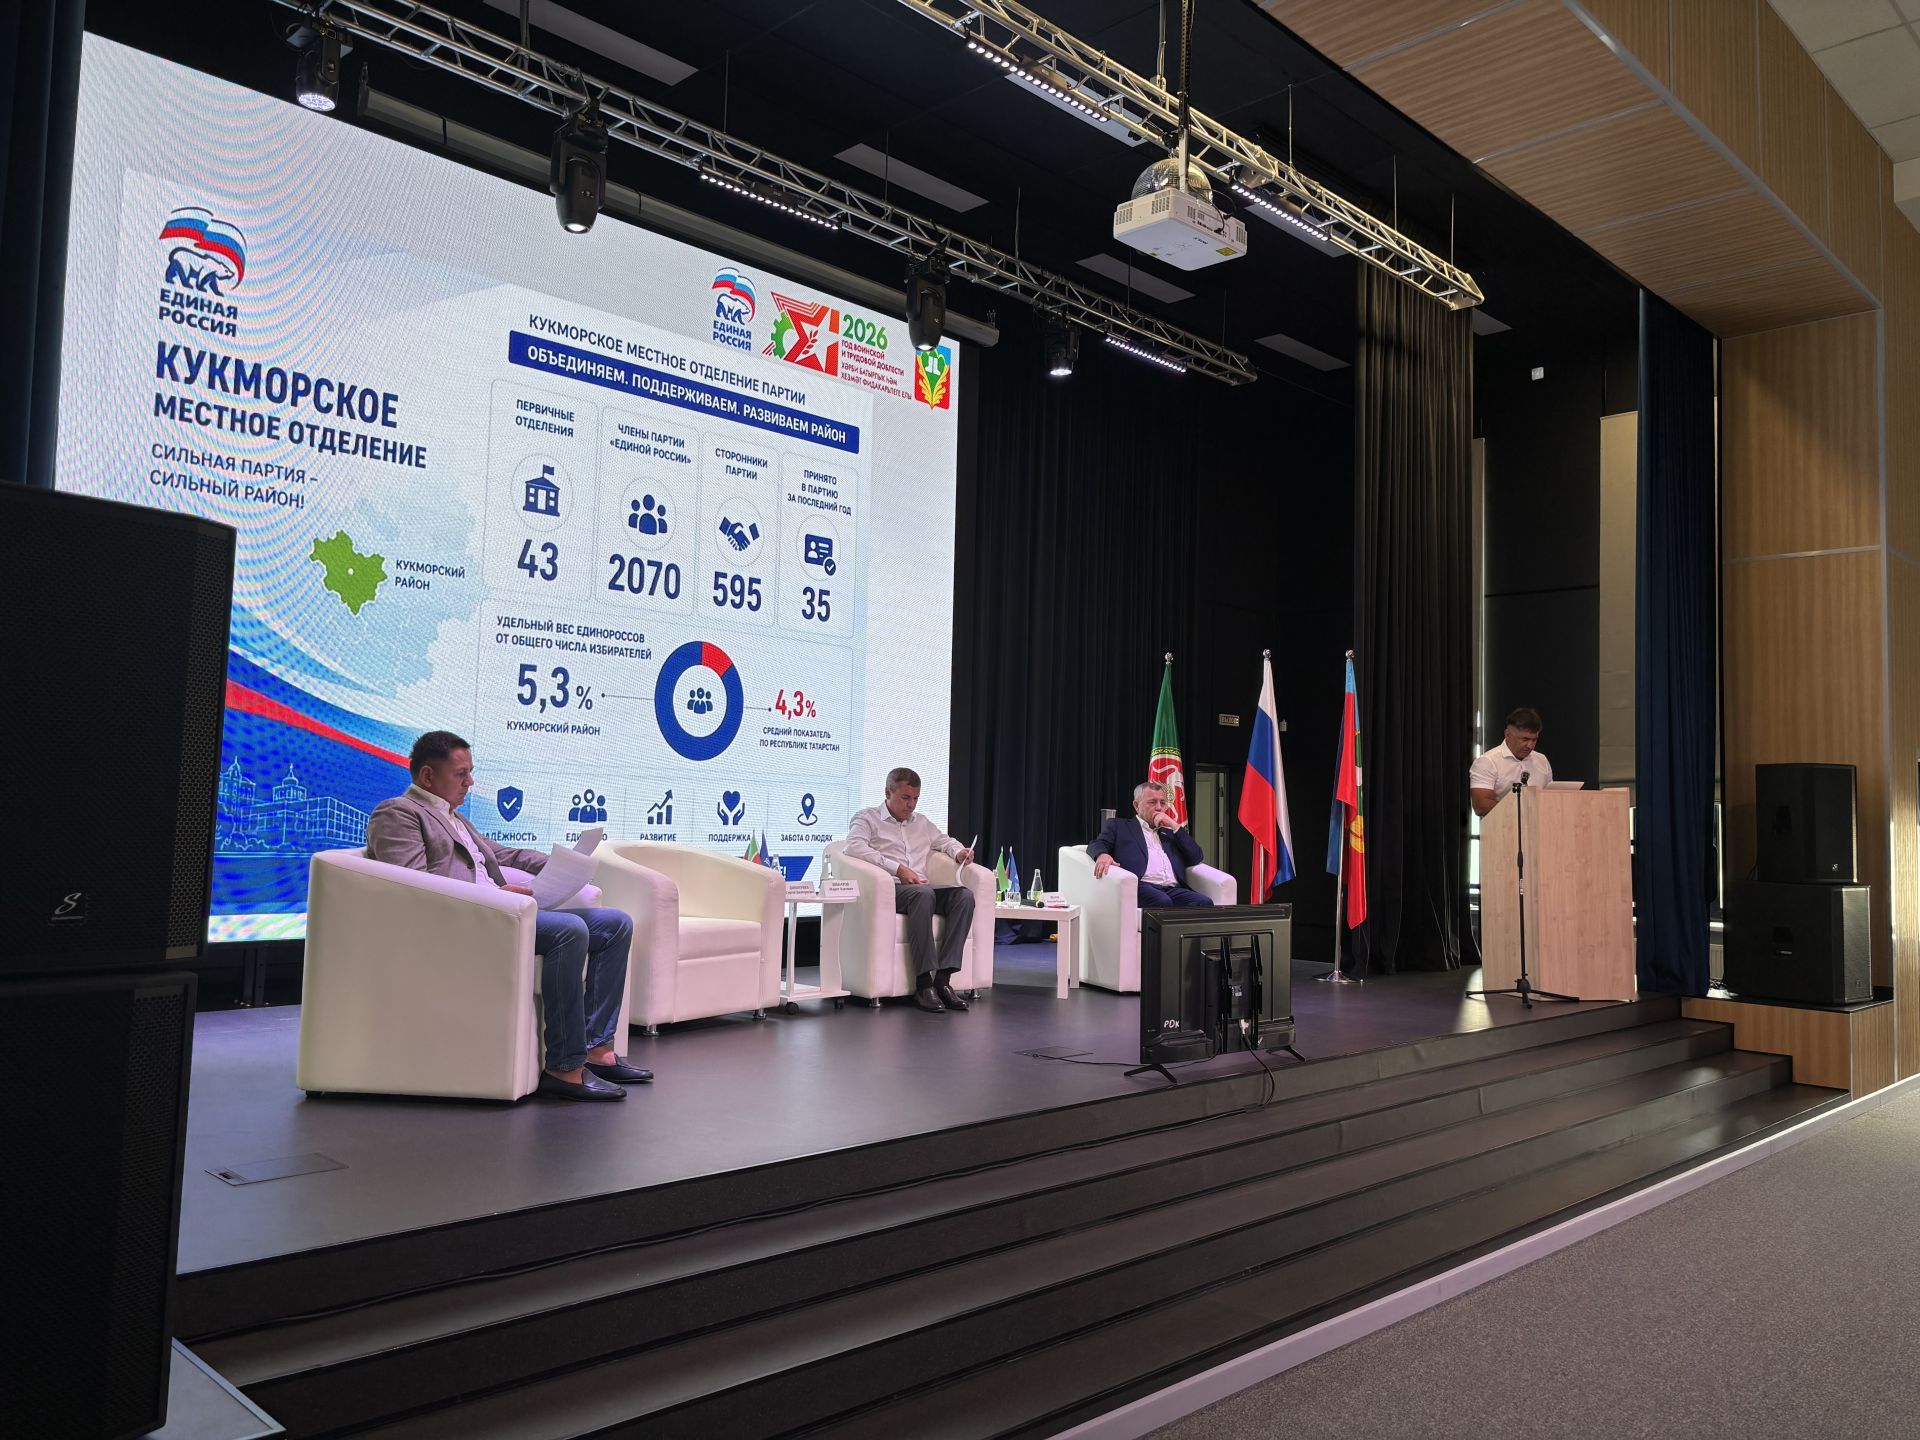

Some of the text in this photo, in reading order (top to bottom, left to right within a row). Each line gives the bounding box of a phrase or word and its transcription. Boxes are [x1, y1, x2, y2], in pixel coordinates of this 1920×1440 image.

[160, 288, 238, 319] ЕДИНАЯ
[159, 306, 237, 337] РОССИЯ
[713, 320, 752, 339] ЕДИНАЯ
[843, 313, 888, 350] 2026
[712, 331, 752, 351] РОССИЯ
[842, 340, 885, 360] ГОД ВОИНСКОЙ
[529, 314, 806, 406] КУКМОРСКОЕ МЕСТНОЕ ОТДЕЛЕНИЕ ПАРТИИ
[847, 352, 876, 367] ТРУДОВОЙ
[877, 362, 904, 376] ДОБЛЕСТИ
[156, 341, 398, 428] КУКМОРСКОЕ
[527, 345, 846, 444] ОБЪЕДИНЯЕМ. ПОДДЕРЖИВАЕМ. РАЗВИВАЕМ РАЙОН
[516, 399, 575, 422] ПЕРВИЧНЫЕ
[154, 392, 427, 469] МЕСТНОЕ ОТДЕЛЕНИЕ
[515, 415, 574, 438] ОТДЕЛЕНИЯ
[618, 424, 685, 448] ЧЛЕНЫ ПАРТИИ
[151, 443, 235, 472] СИЛЬНАЯ
[241, 460, 306, 484] ПАРТИЯ
[610, 438, 692, 465] «ЕДИНОЙ РОССИИ»
[715, 448, 768, 469] СТОРОННИКИ
[725, 464, 758, 480] ПАРТИИ
[804, 470, 837, 486] ПРИНЯТО
[150, 469, 305, 509] СИЛЬНЫЙ РАЙОН!
[802, 482, 838, 500] В ПАРТИЮ
[787, 492, 852, 516] ЗА ПОСЛЕДНИЙ ГОД
[396, 559, 466, 579] КУКМОРСКИЙ
[517, 538, 559, 582] 43
[395, 576, 430, 590] РАЙОН
[608, 553, 681, 600] 2070
[713, 571, 762, 612] 595
[801, 586, 831, 622] 35
[496, 615, 645, 644] УДЕЛЬНЫЙ ВЕС ЕДИНОРОССОВ
[496, 633, 652, 661] ОТ ОБЩЕГО ЧИСЛА ИЗБИРАТЕЛЕЙ
[506, 720, 600, 736] КУКМОРСКИЙ РАЙОН
[762, 726, 832, 739] СРЕДНИЙ ПОКАЗАТЕЛЬ
[759, 739, 840, 752] ПО РЕСПУБЛИКЕ ТАТАРСТАН
[640, 833, 677, 842] РАЗВИТИЕ
[708, 834, 751, 843] ПОДДЕРЖКА
[780, 834, 833, 843] ЗАБОТА О ЛЮДЯХ
